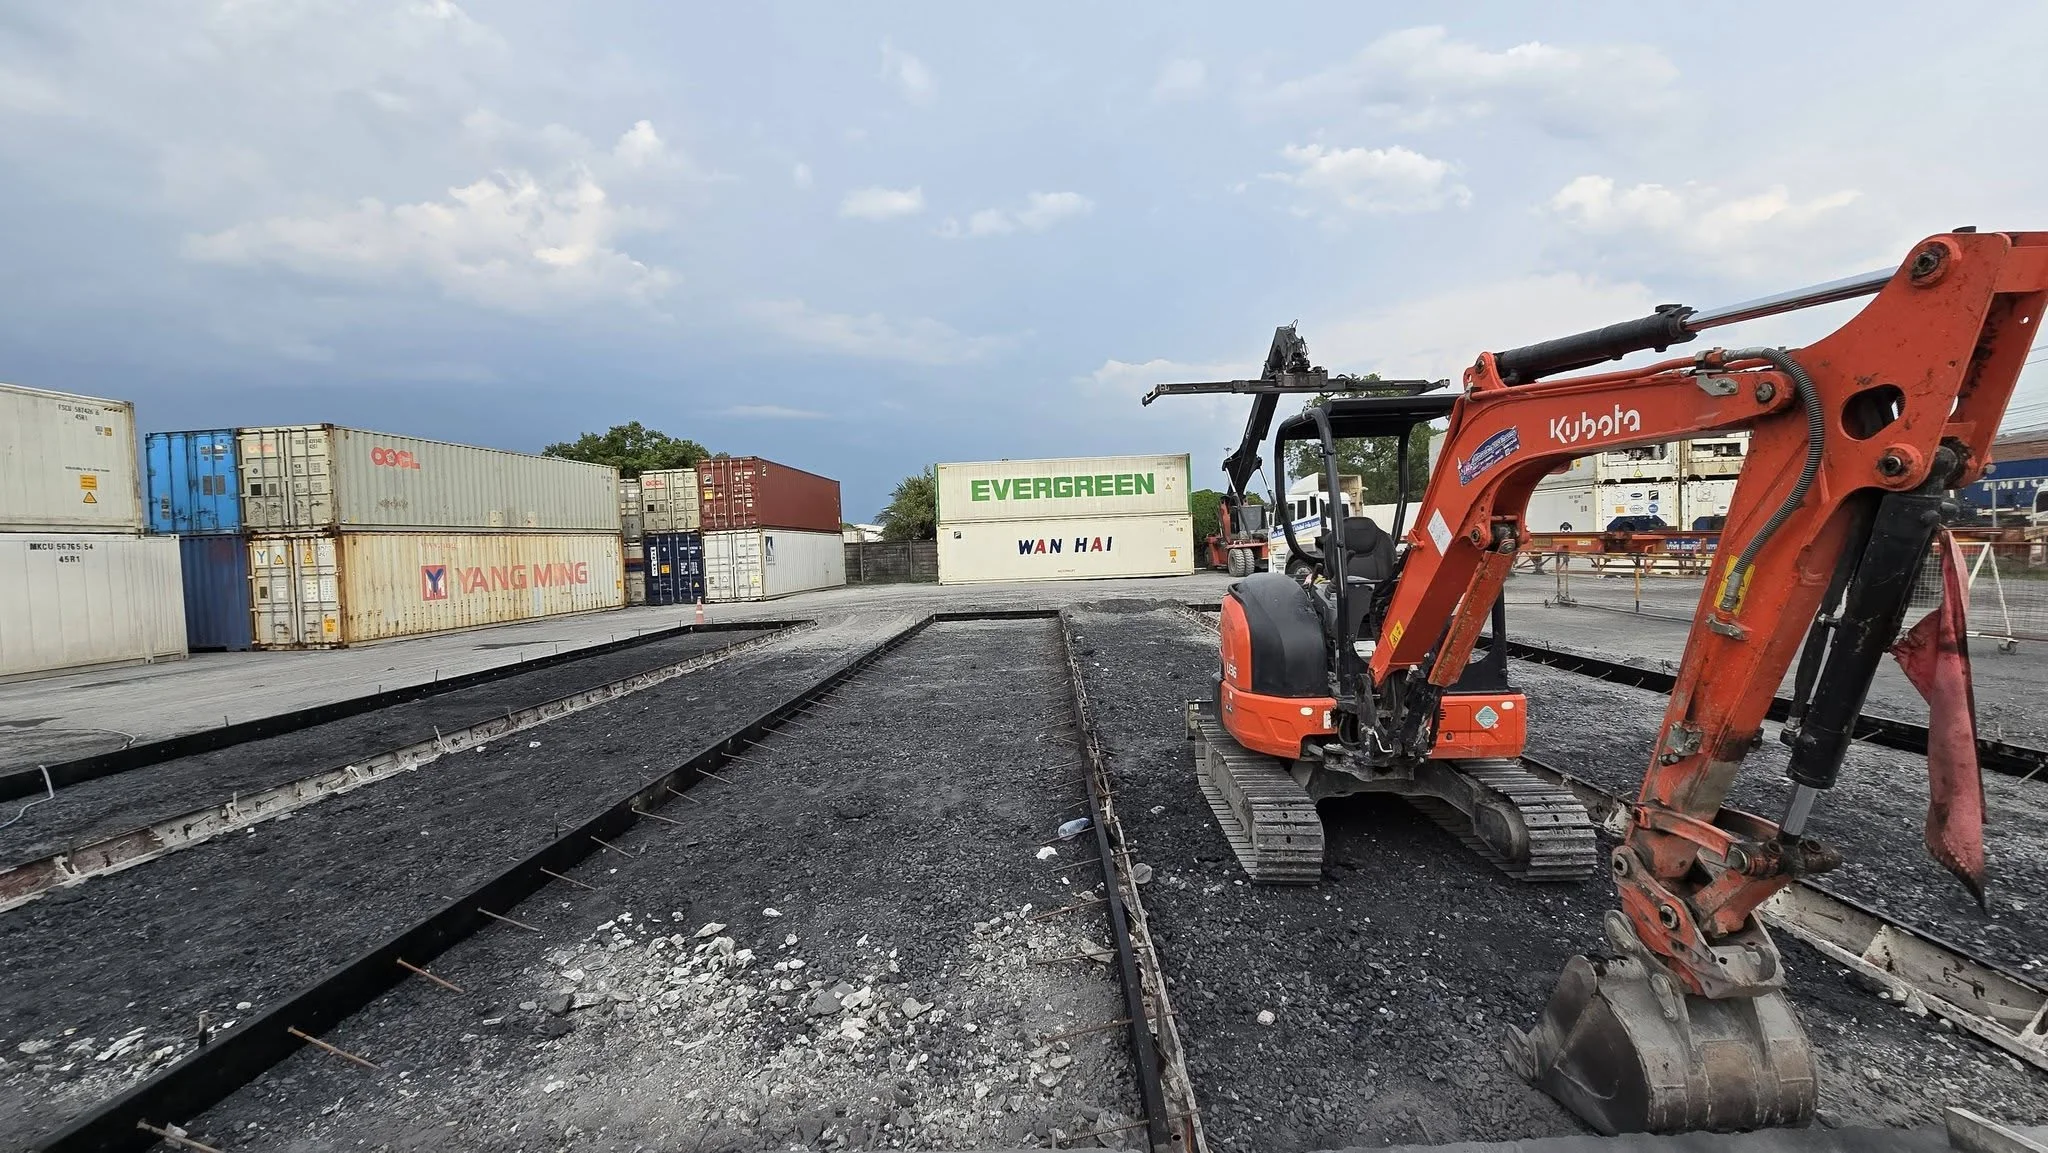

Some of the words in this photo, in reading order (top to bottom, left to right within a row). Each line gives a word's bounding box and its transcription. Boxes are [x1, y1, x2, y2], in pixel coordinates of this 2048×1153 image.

[1550, 403, 1641, 444] Kubota
[371, 447, 421, 470] OOCL
[971, 472, 1155, 502] EVERGREEN
[58, 555, 81, 563] 45R1
[1018, 537, 1063, 556] WAN
[1074, 536, 1113, 553] HAI
[455, 565, 528, 594] YANG
[533, 561, 588, 588] MING
